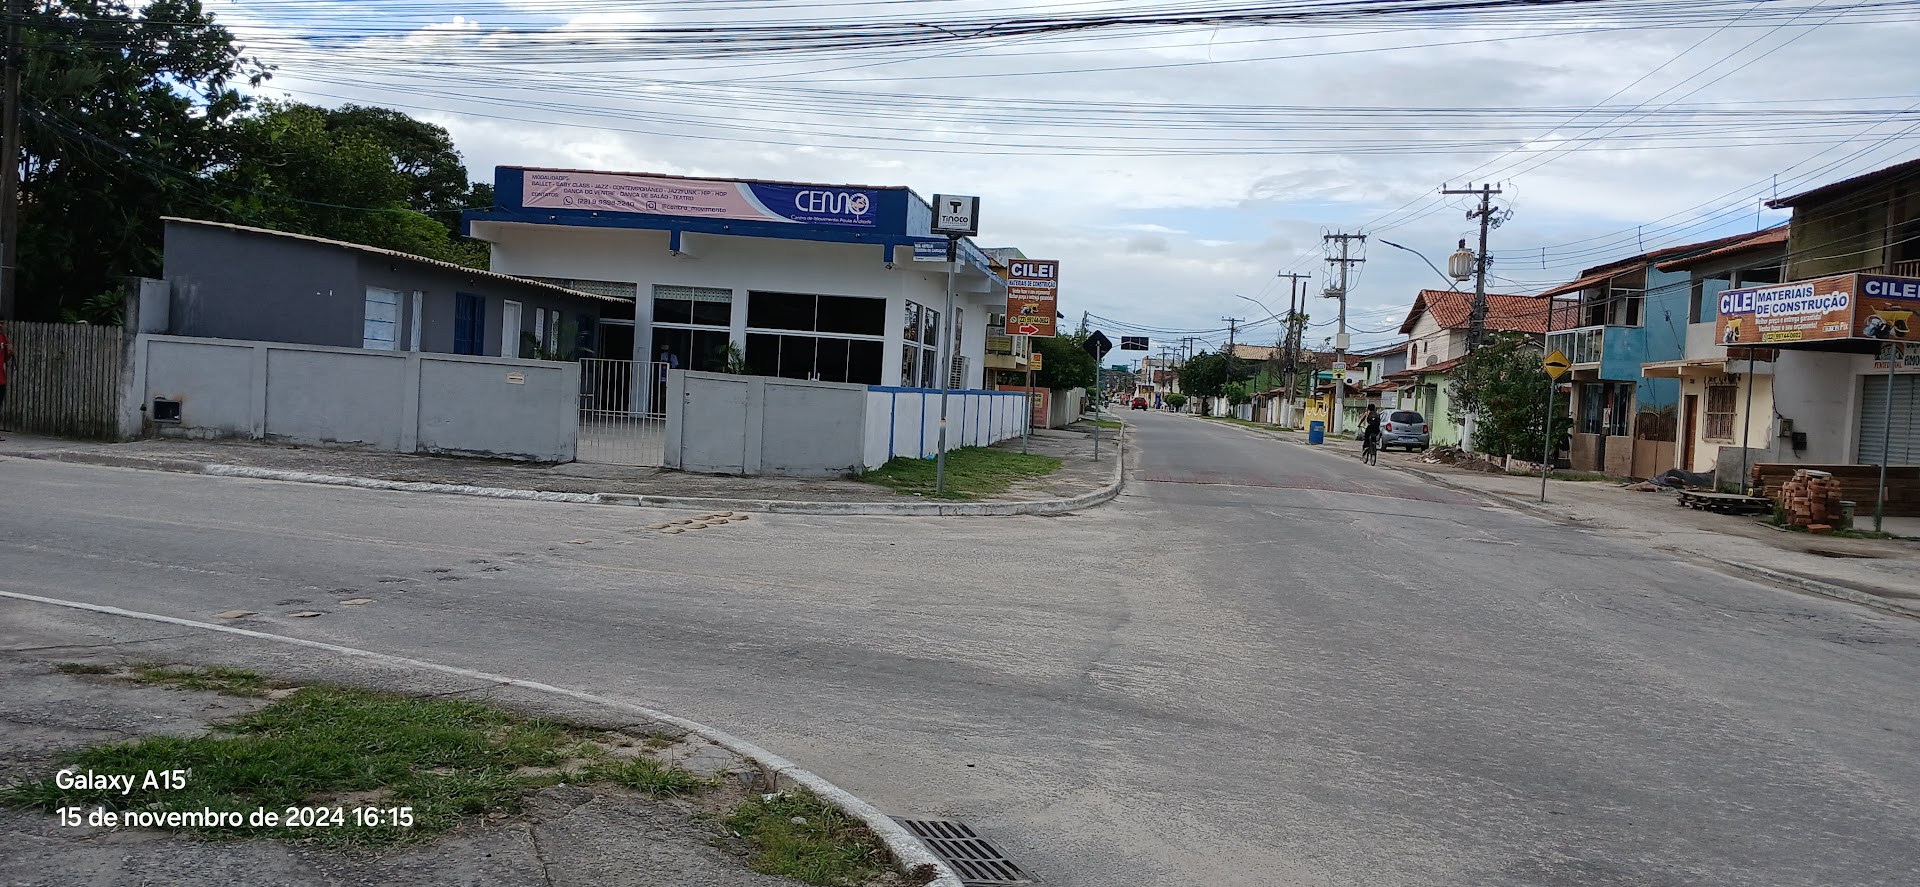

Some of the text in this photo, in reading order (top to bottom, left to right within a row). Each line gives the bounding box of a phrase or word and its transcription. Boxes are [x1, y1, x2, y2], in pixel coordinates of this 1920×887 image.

[950, 201, 962, 213] T
[1011, 263, 1054, 278] CILEI
[1033, 280, 1056, 288] CONSTRUÇÃO
[1721, 287, 1812, 313] CILEI MATERIAIS
[1757, 295, 1847, 314] DE CONSTRUÇÃO
[1840, 322, 1848, 330] Pix
